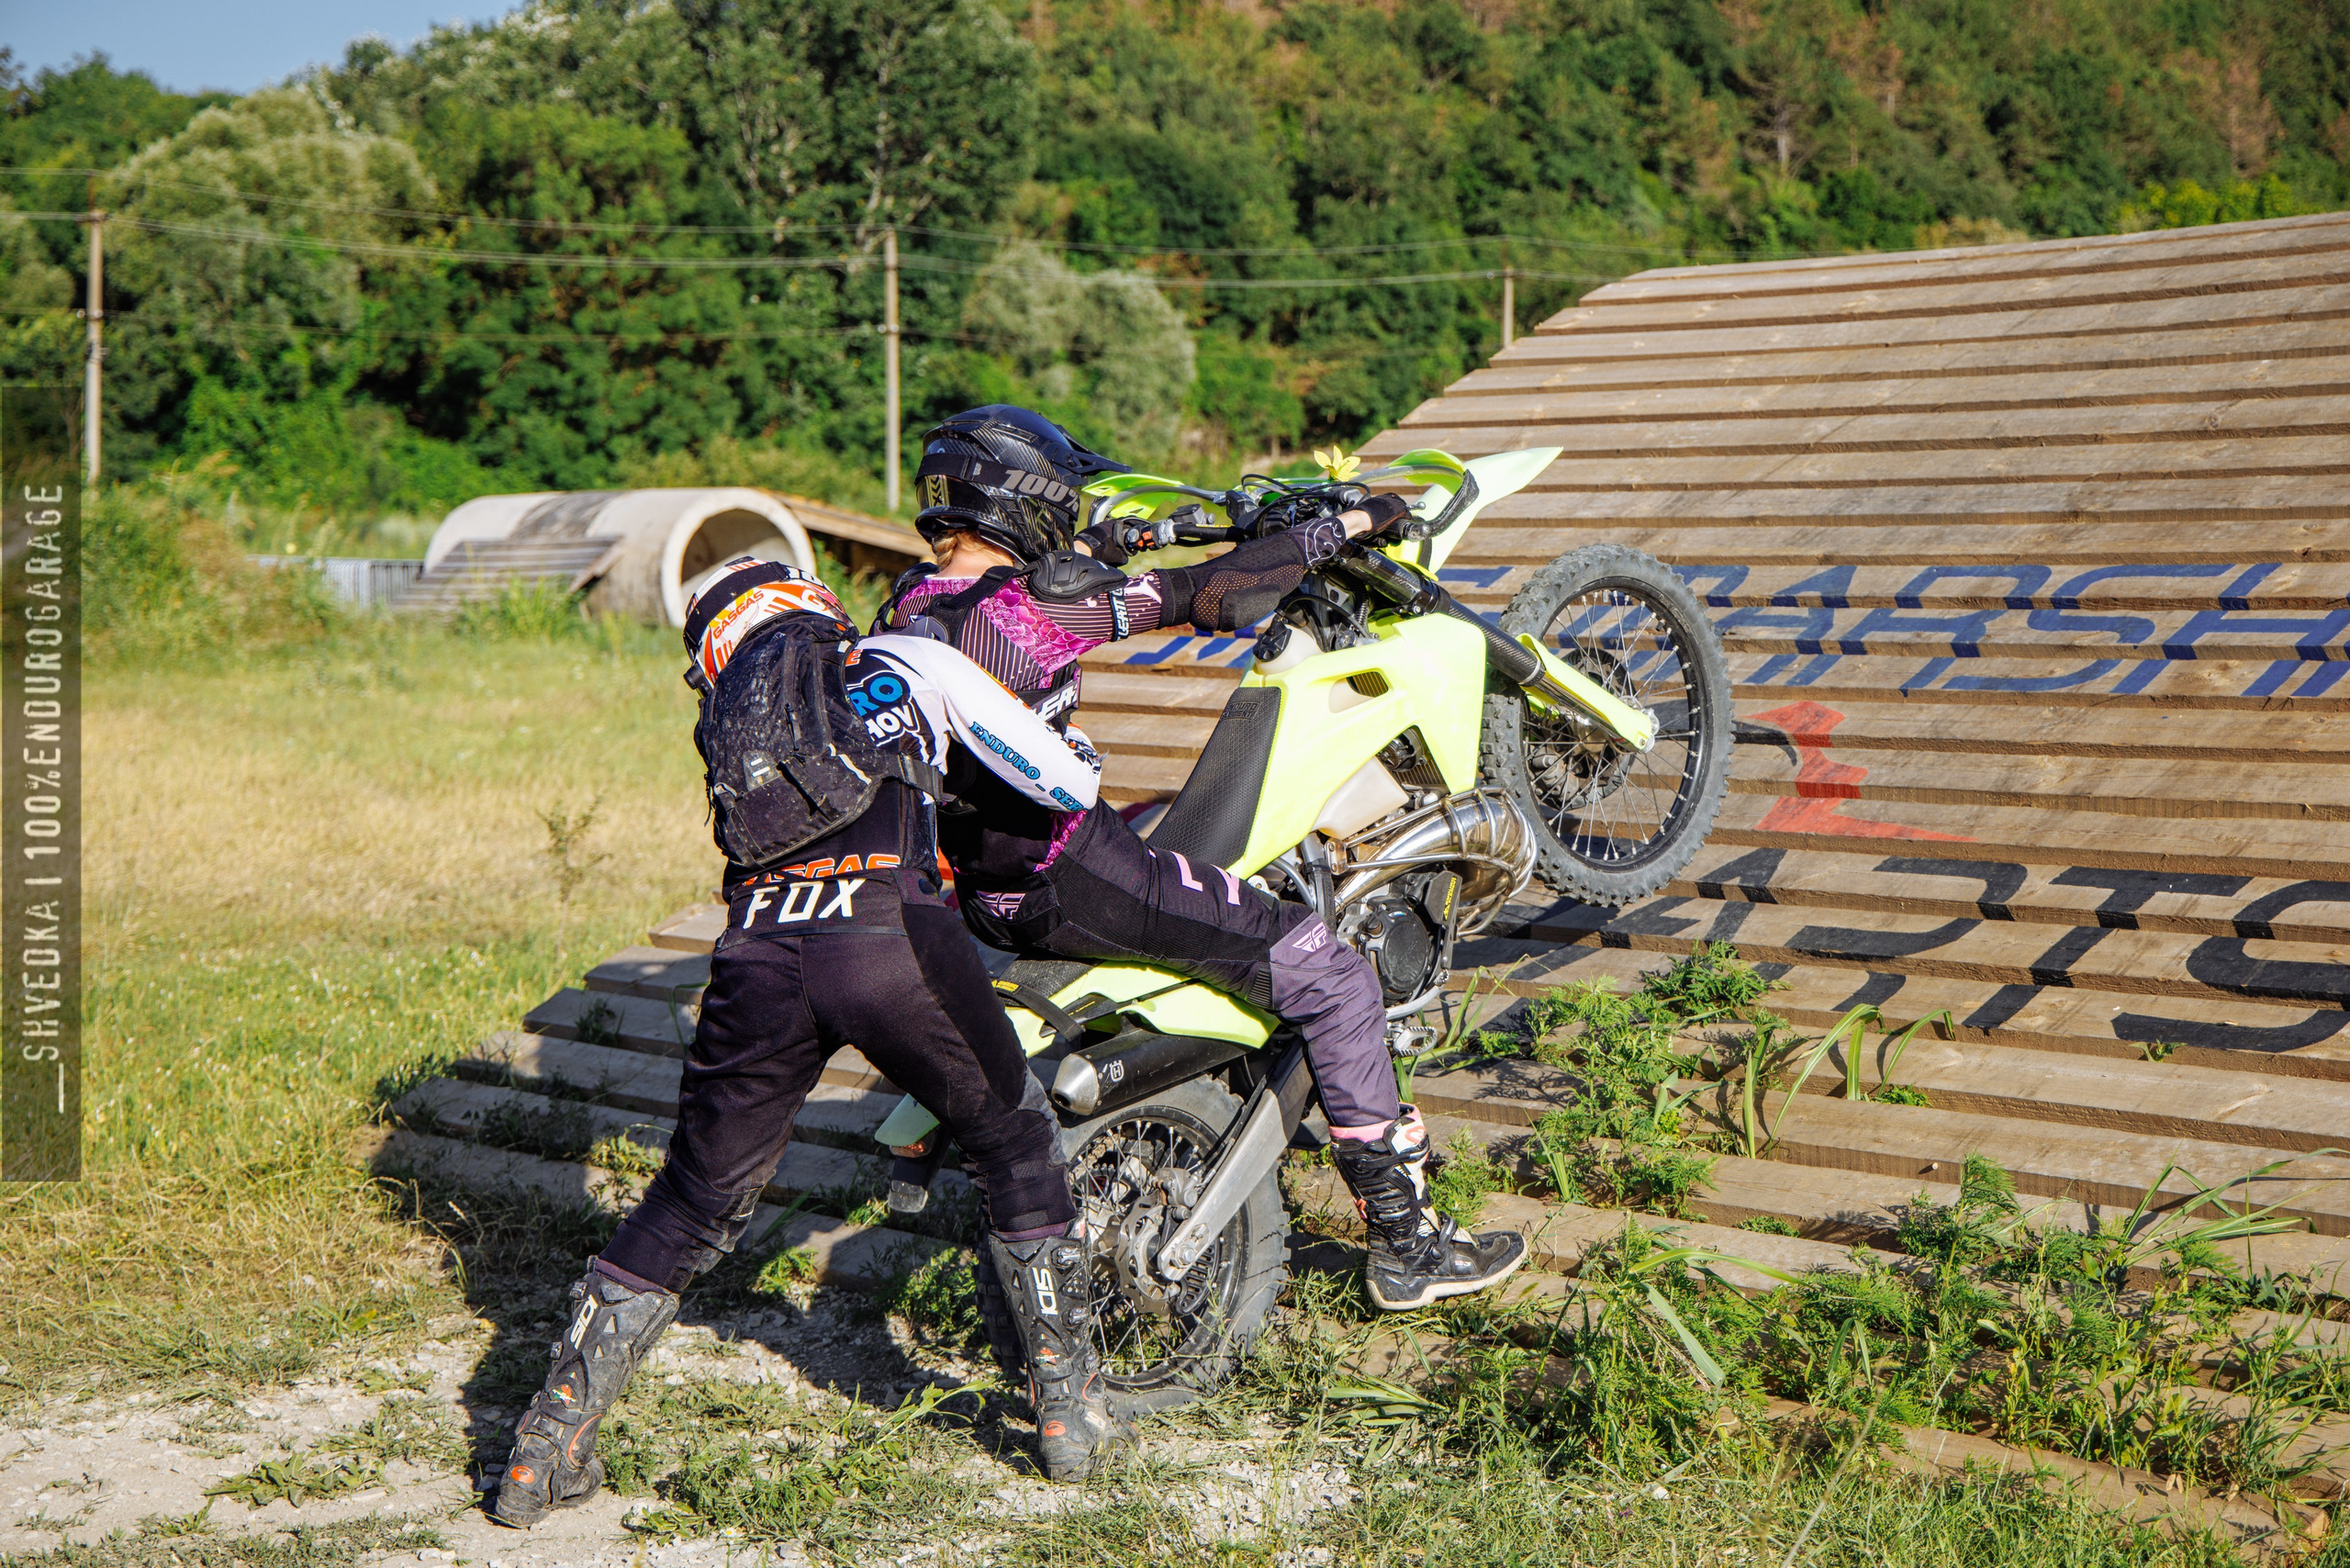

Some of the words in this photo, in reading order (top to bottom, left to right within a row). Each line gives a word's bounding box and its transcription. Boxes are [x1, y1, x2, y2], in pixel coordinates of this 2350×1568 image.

[1002, 469, 1080, 513] 100%
[712, 590, 765, 640] GASGAS
[968, 722, 1041, 780] ENDURO
[743, 879, 867, 929] FOX
